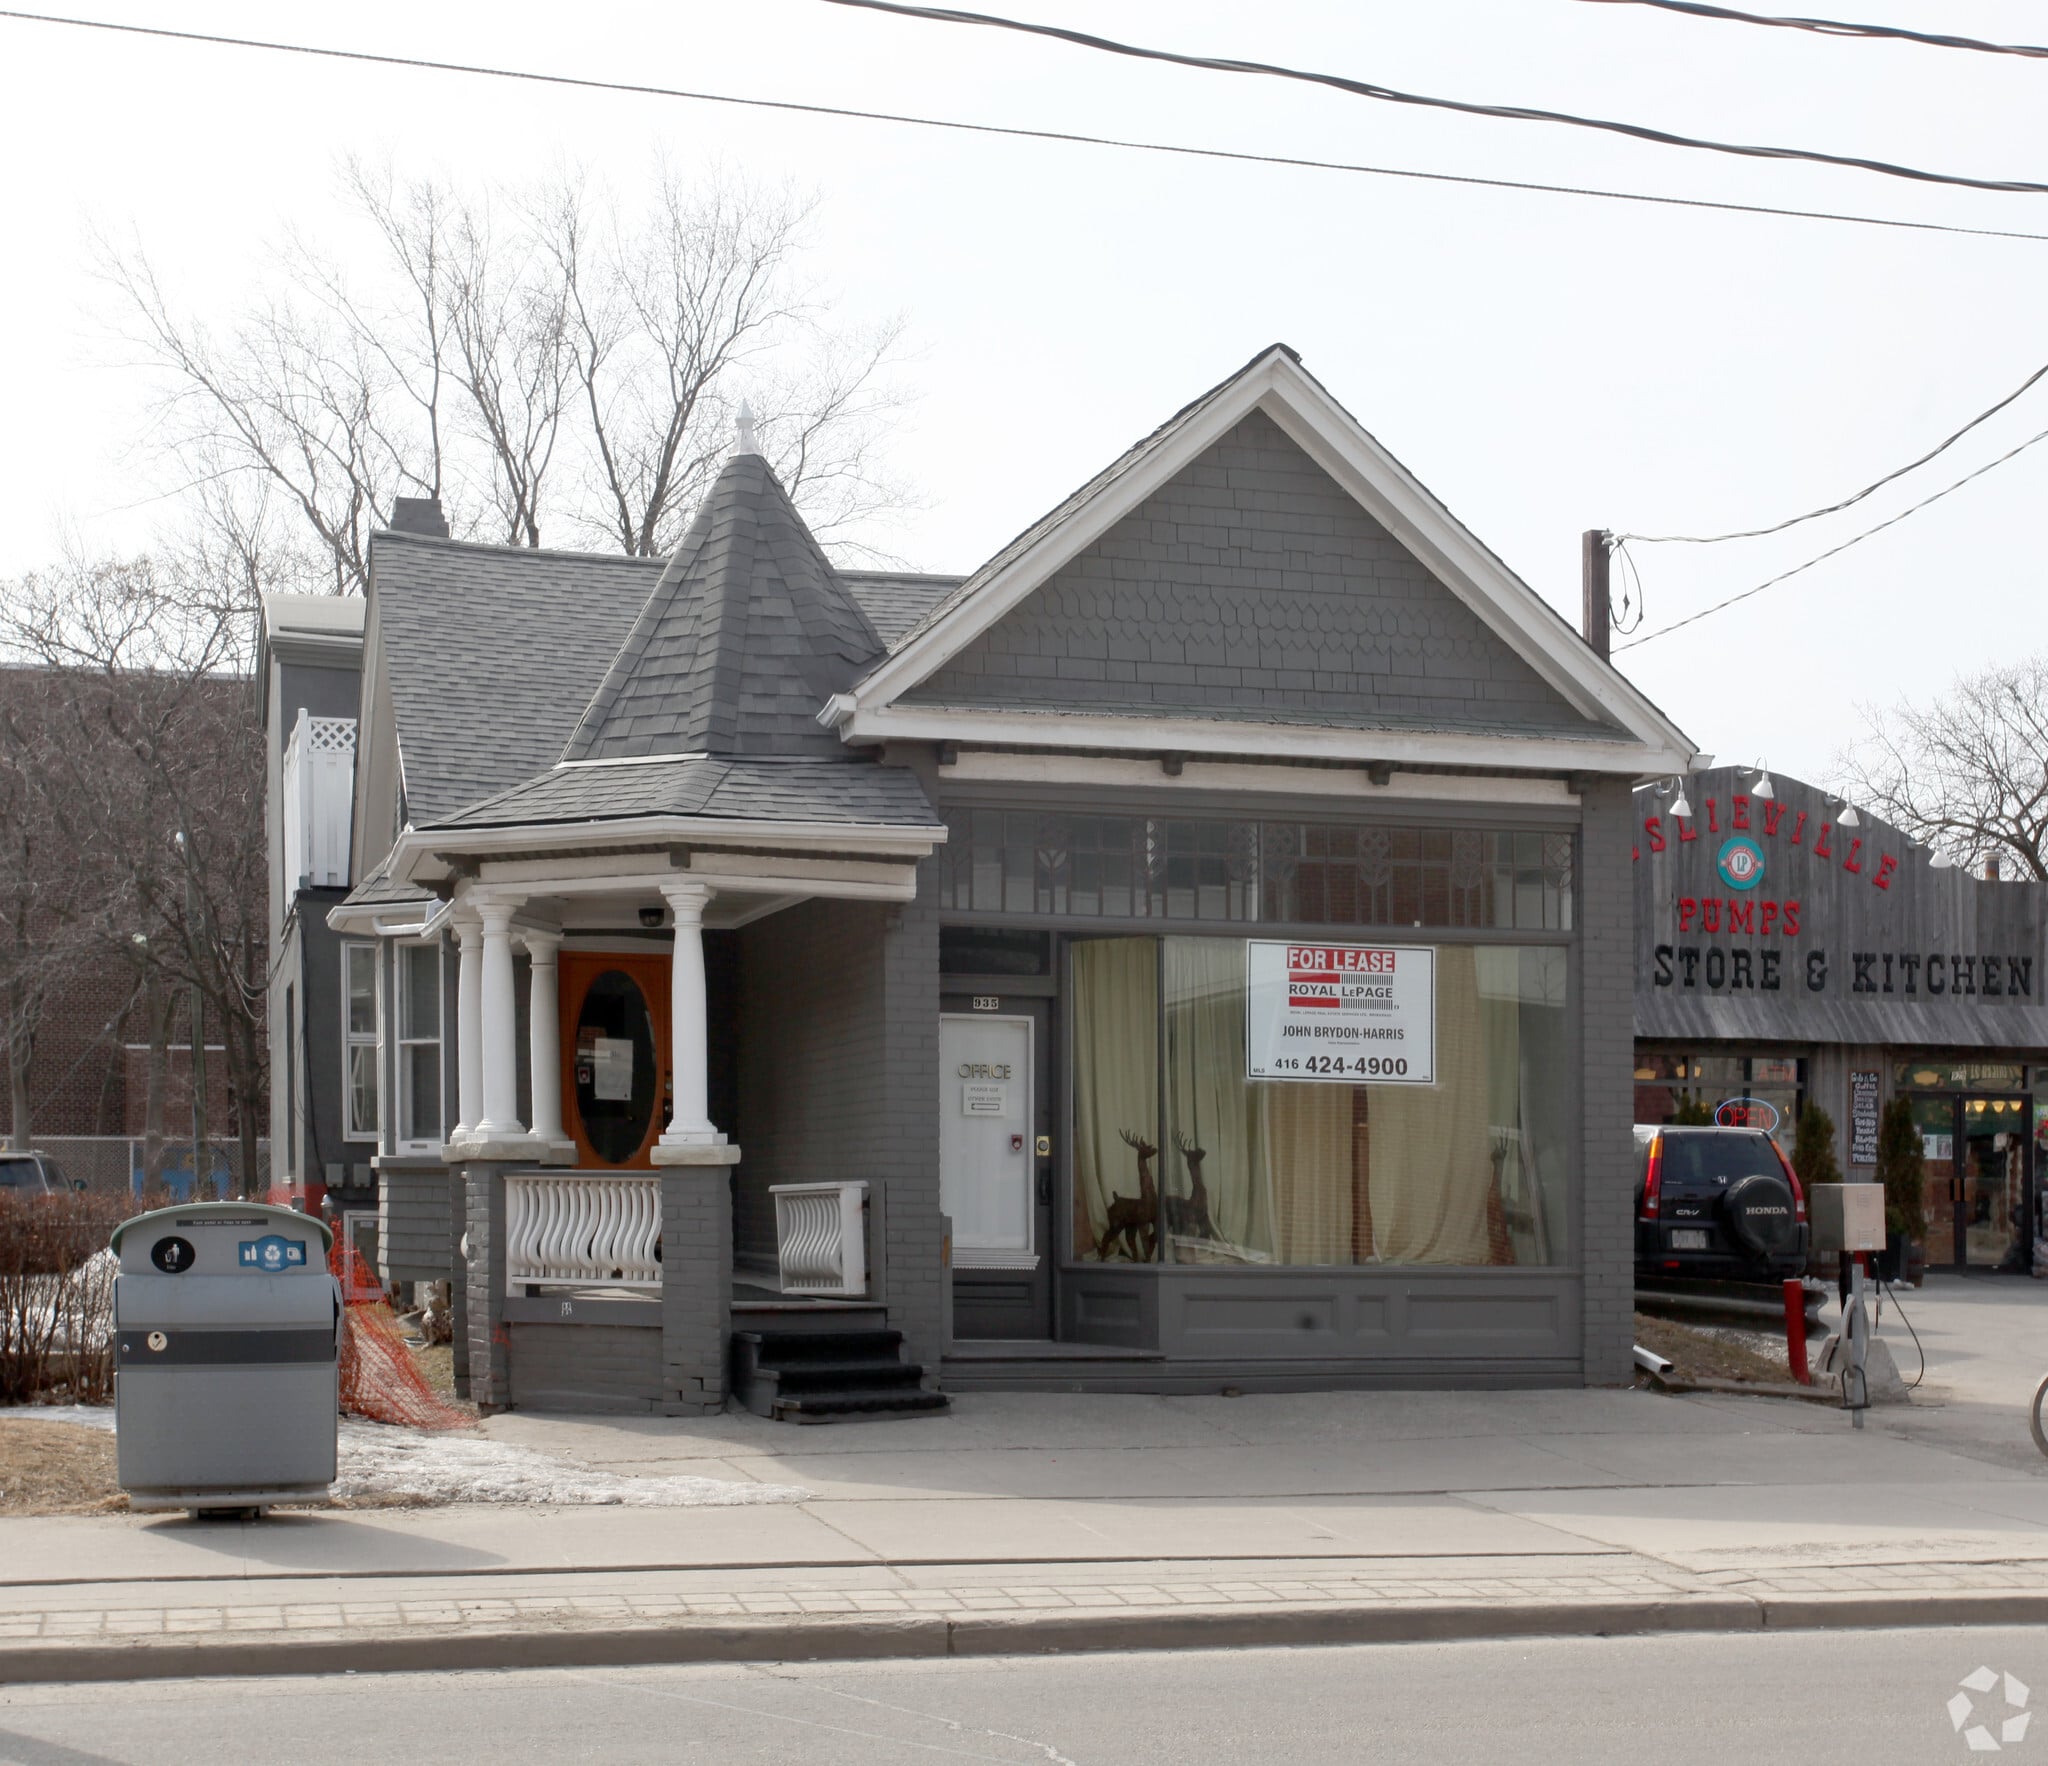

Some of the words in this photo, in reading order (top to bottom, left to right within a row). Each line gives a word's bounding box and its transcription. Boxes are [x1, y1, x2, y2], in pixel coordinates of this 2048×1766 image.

[1632, 795, 1898, 890] SLIEVILLE
[1678, 897, 1801, 937] PUMPS
[1288, 949, 1326, 969] FOR
[1333, 951, 1393, 972] LEASE
[1654, 944, 1781, 991] STORE
[1806, 948, 1828, 992] &
[1852, 952, 2033, 997] KITCHEN
[1289, 984, 1336, 997] ROYAL
[974, 998, 998, 1008] 935
[1282, 1025, 1312, 1038] JOHN
[1314, 1026, 1405, 1040] BRYDON-HARRIS
[958, 1064, 1011, 1080] OFFICE
[1275, 1058, 1299, 1070] 416
[1305, 1056, 1408, 1075] 424-4900
[1718, 1105, 1773, 1130] OPEN
[1745, 1206, 1788, 1215] HONDA
